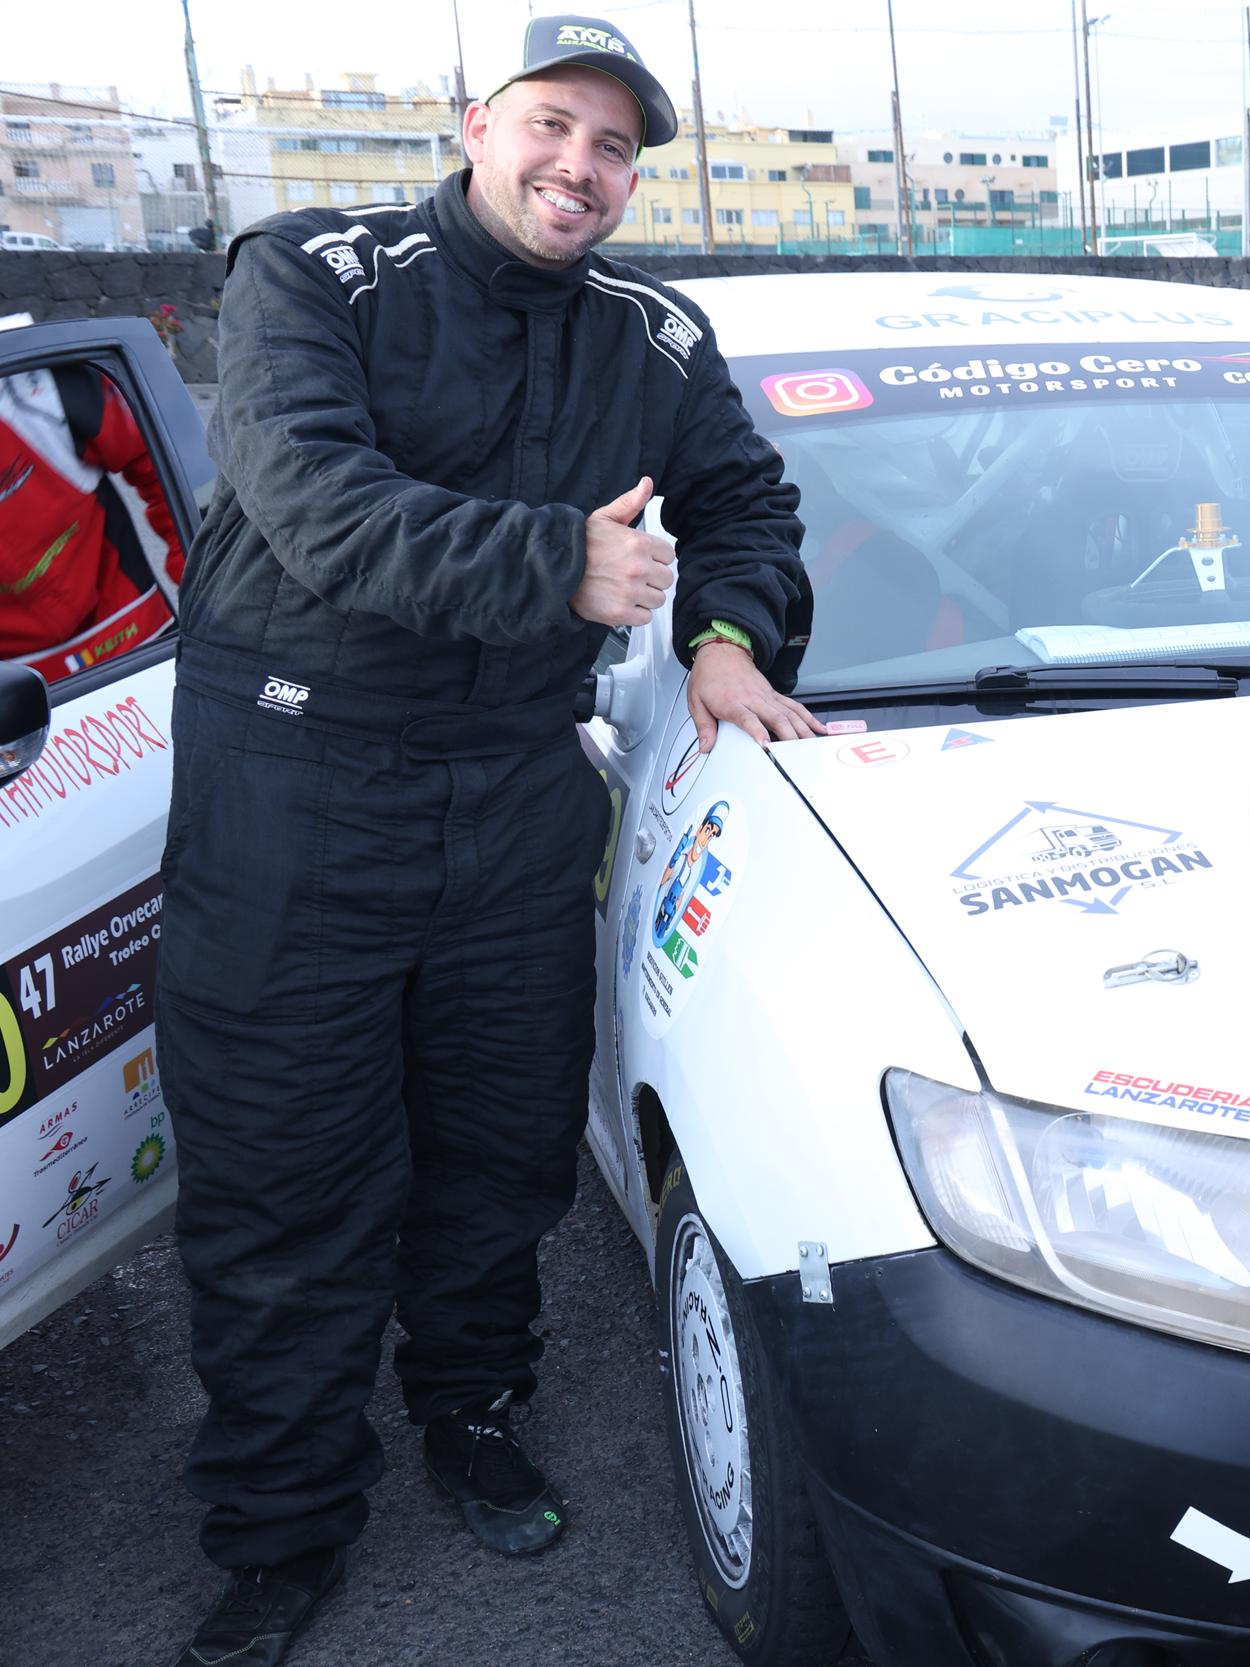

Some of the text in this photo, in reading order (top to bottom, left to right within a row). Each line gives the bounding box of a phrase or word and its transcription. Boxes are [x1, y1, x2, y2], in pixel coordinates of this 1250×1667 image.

[664, 318, 695, 348] OMP
[875, 309, 1234, 330] GRACIPLUS
[879, 355, 1203, 387] Código Cero
[939, 376, 1177, 400] MOTORSPORT
[264, 681, 309, 704] OMP
[850, 741, 897, 763] E
[1060, 841, 1198, 873] DISTRIBUCIONES
[959, 850, 1213, 916] SANMOGAN
[61, 927, 109, 969] Rallye
[109, 935, 149, 966] Trofeo
[20, 953, 56, 1019] 47
[43, 992, 145, 1070] LANZAROTE
[39, 1101, 79, 1135] ARMAS
[151, 1111, 166, 1129] bp
[56, 1198, 99, 1241] CICAR
